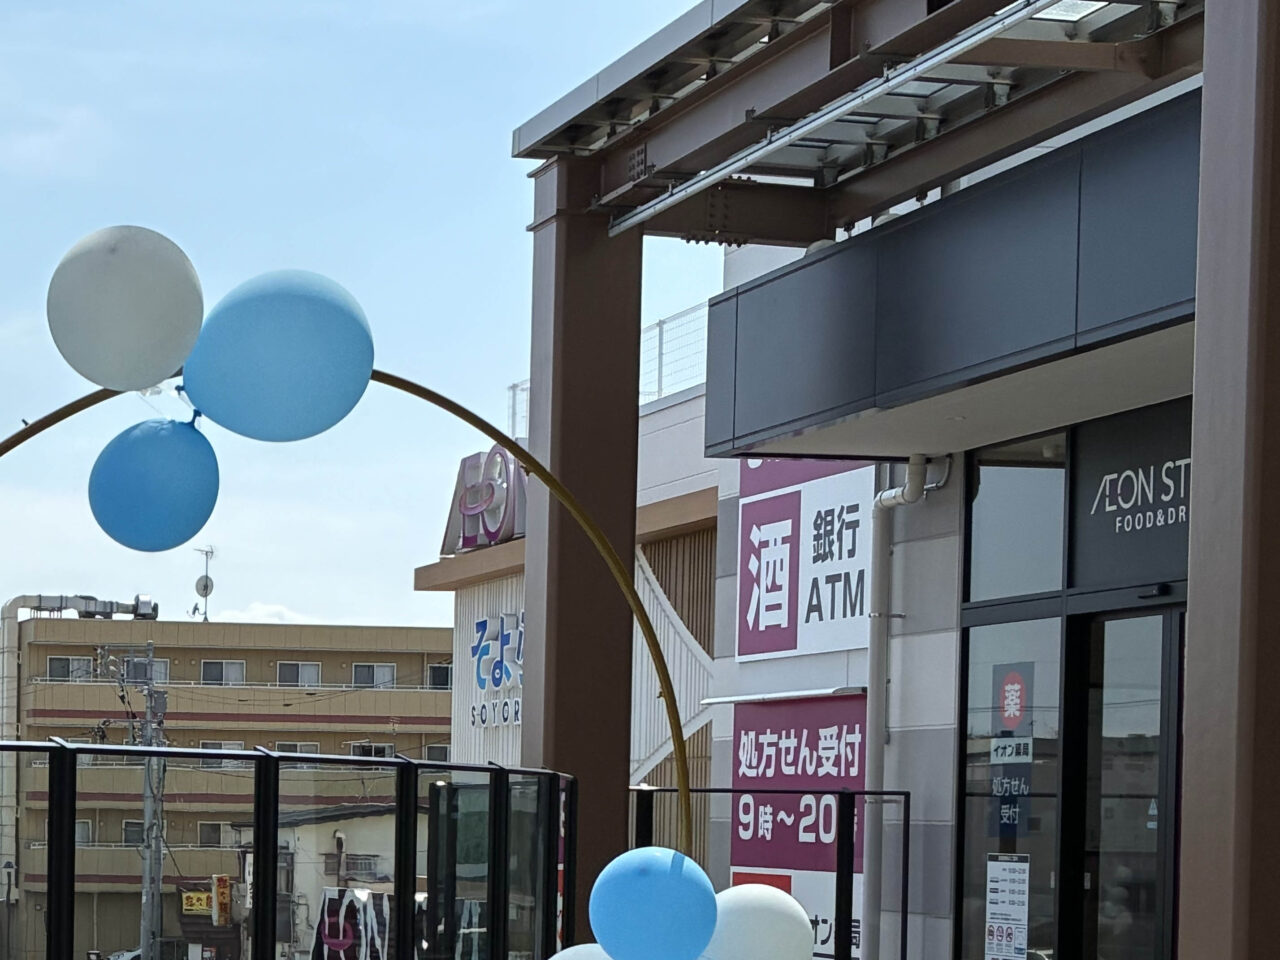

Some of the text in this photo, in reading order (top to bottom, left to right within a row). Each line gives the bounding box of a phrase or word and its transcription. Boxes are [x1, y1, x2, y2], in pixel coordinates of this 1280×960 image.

[1161, 458, 1191, 502] ST
[813, 503, 860, 564] 銀行
[1116, 505, 1186, 533] FOOD&DR
[746, 519, 792, 631] 酒
[805, 568, 865, 624] ATM
[1004, 683, 1021, 718] 薬
[738, 723, 862, 778] 処方せん受付
[993, 743, 1030, 758] イオン薬局
[992, 777, 1029, 796] 処方せん
[738, 793, 857, 843] 9時～20
[1000, 804, 1020, 825] 受付
